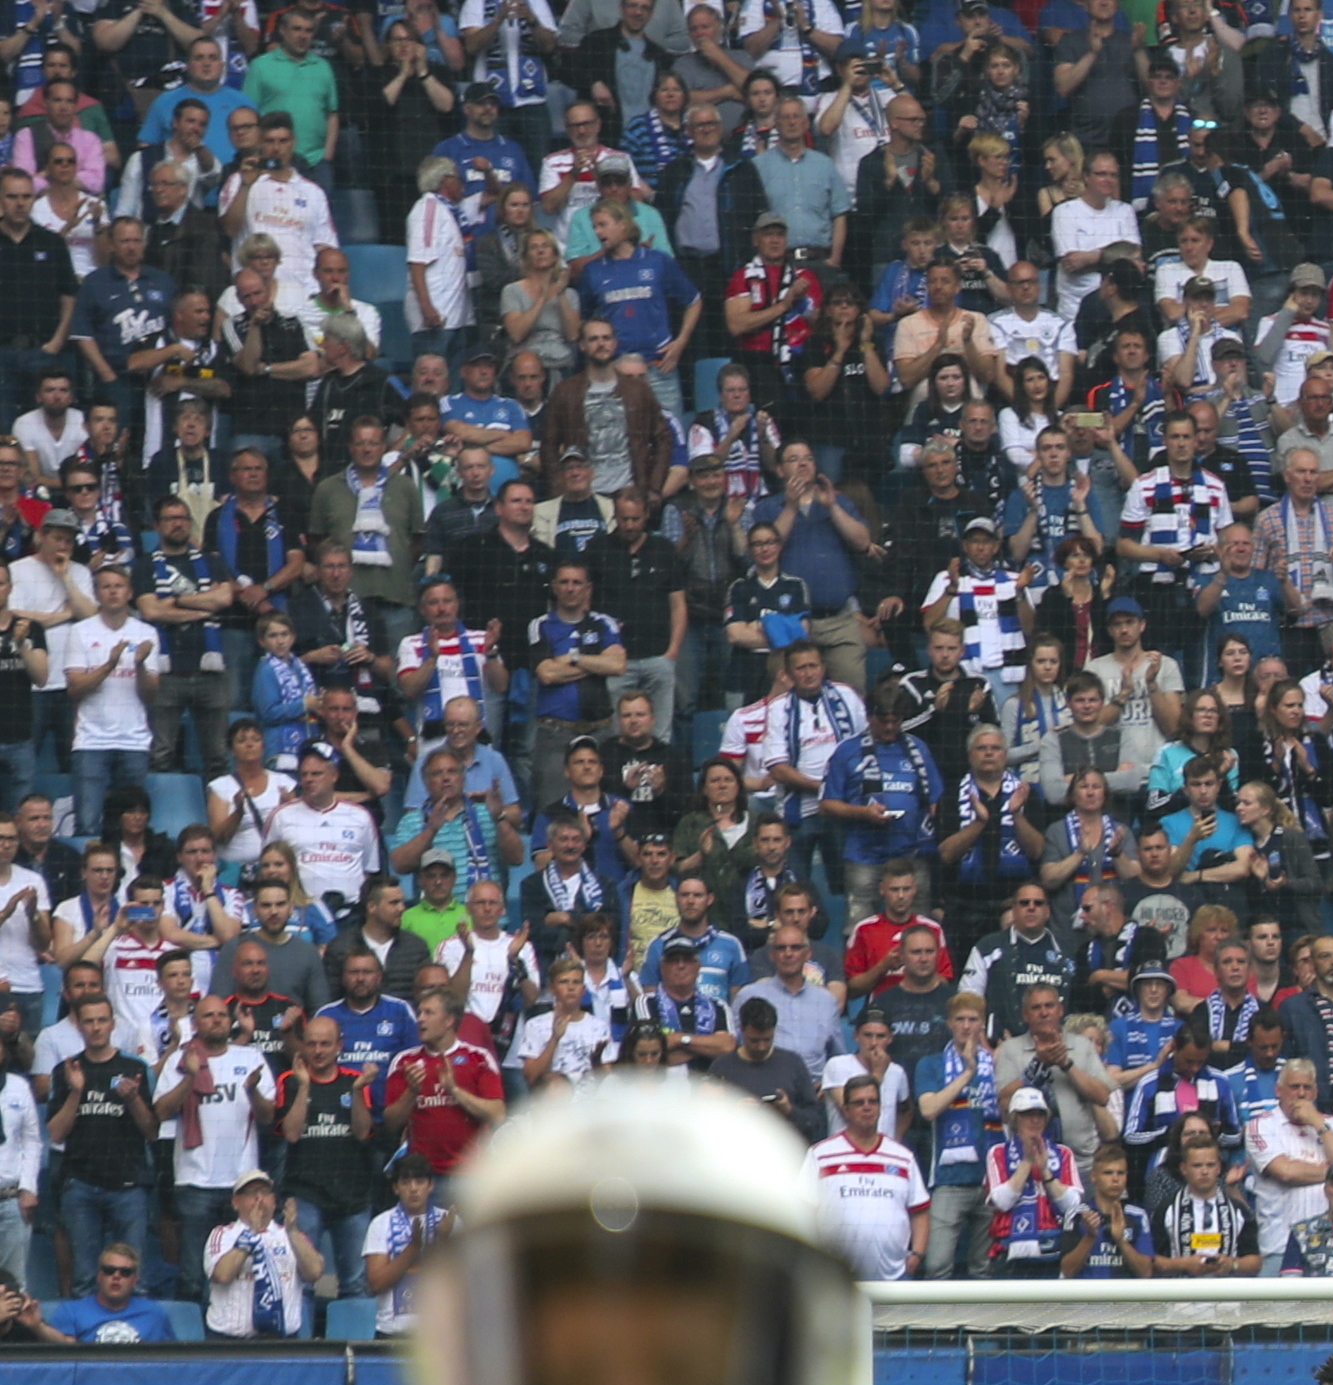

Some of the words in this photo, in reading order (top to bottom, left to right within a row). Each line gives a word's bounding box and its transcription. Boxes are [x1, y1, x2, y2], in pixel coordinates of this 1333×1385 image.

[1239, 602, 1257, 613] Fly
[1222, 611, 1271, 623] Emirates
[882, 781, 914, 792] rates
[319, 847, 337, 858] Fly
[301, 856, 353, 871] Emirates
[1026, 966, 1043, 978] Fly
[471, 982, 505, 995] mira
[1015, 976, 1061, 989] mirates
[125, 983, 162, 997] Emir
[353, 1040, 372, 1053] Fly
[87, 1089, 105, 1102] Fly
[417, 1095, 458, 1108] Emira
[78, 1101, 124, 1117] mirates
[318, 1112, 336, 1125] Fly
[301, 1123, 352, 1137] mirate
[858, 1176, 874, 1190] Fly
[839, 1187, 895, 1202] Emirates
[1101, 1242, 1116, 1254] Fly
[1091, 1252, 1123, 1267] mira
